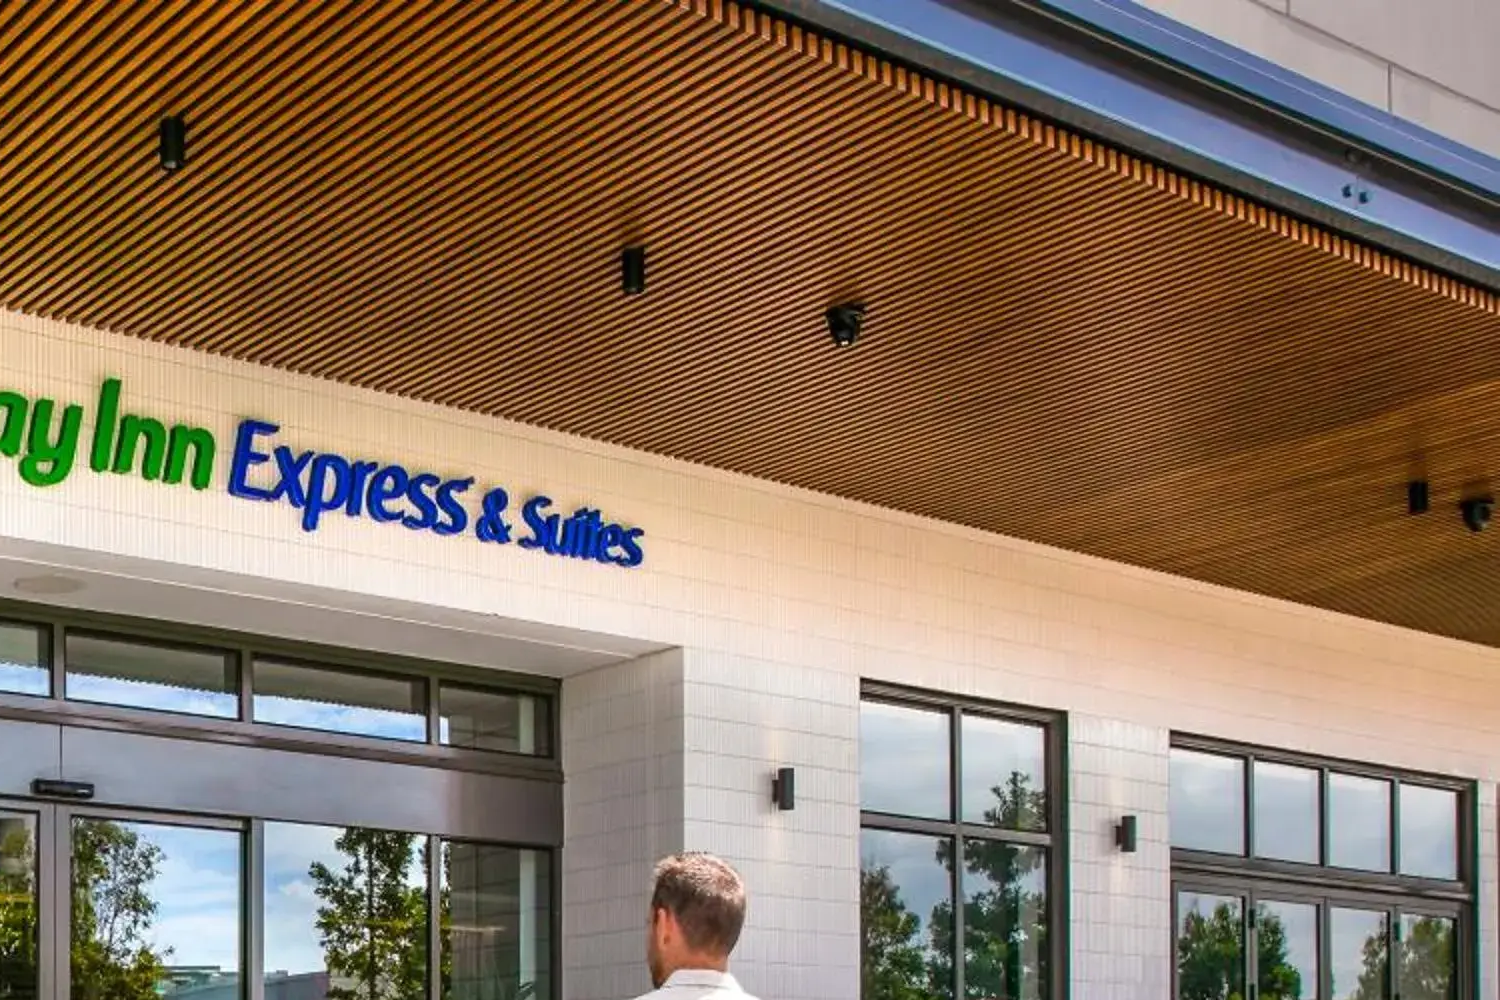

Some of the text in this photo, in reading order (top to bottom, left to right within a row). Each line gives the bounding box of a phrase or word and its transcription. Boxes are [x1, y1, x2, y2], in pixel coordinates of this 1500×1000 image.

[90, 378, 216, 490] Inn
[227, 419, 471, 534] Express
[475, 487, 512, 544] &
[519, 495, 644, 567] Suites
